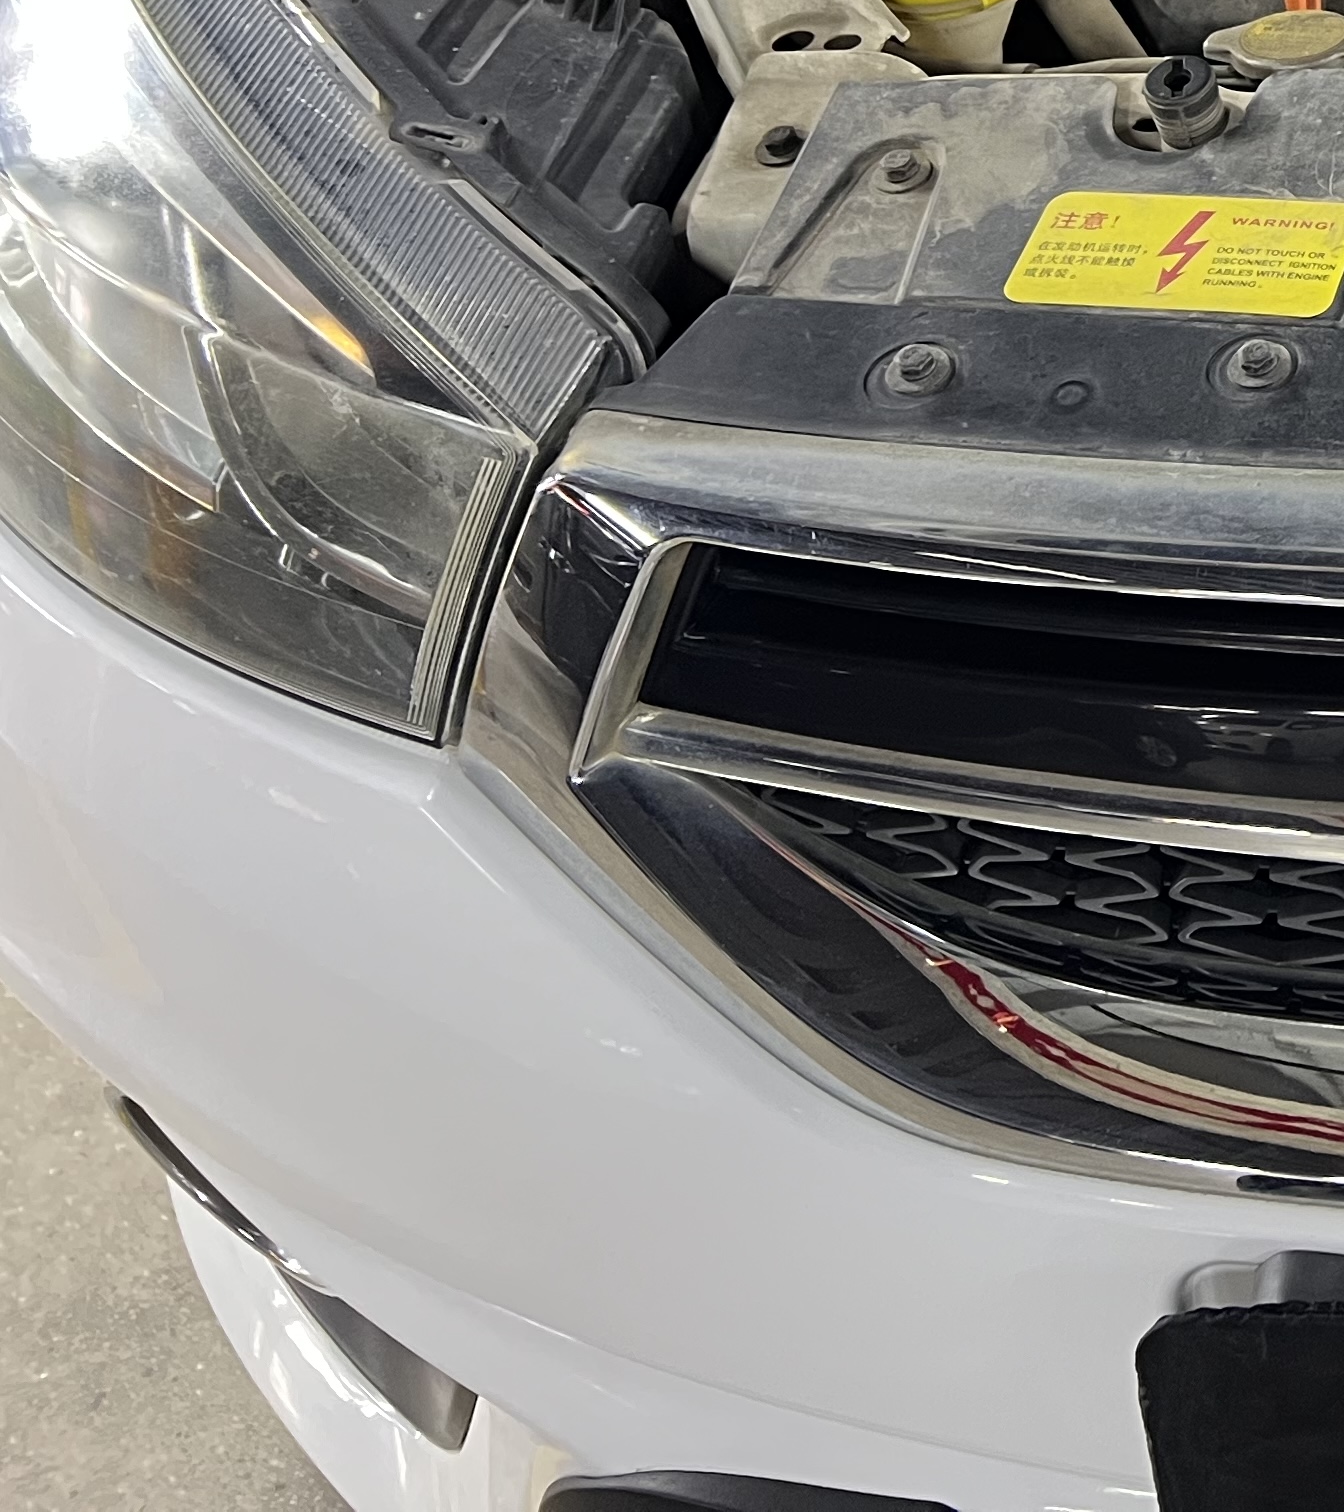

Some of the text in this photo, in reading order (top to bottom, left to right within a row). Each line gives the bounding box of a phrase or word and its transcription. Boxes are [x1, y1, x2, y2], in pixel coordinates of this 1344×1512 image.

[1050, 211, 1121, 231] 注意！
[1231, 217, 1336, 231] WARNING!
[1216, 246, 1326, 260] DO NOT TOUCH OR
[1211, 257, 1337, 271] DISCONNECT IGNITION
[1207, 267, 1331, 282] CABLES WITH ENGINE
